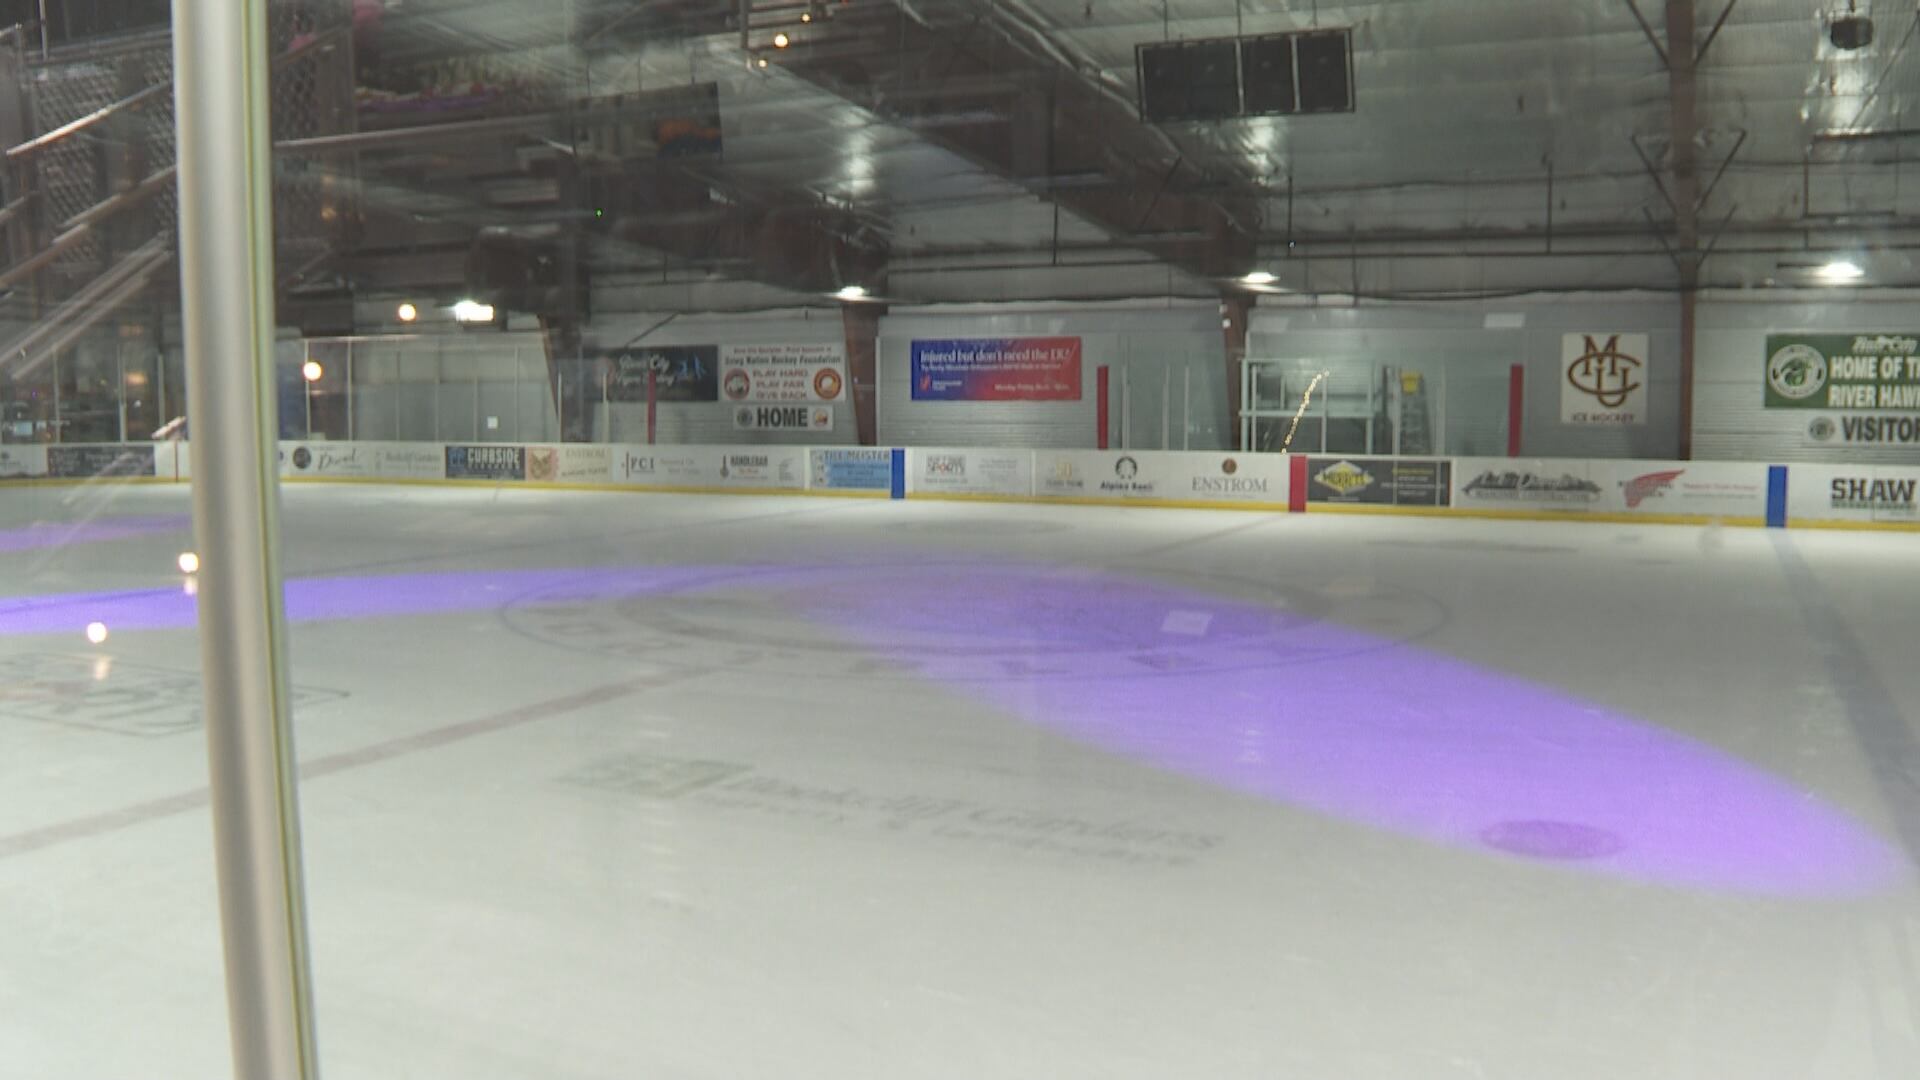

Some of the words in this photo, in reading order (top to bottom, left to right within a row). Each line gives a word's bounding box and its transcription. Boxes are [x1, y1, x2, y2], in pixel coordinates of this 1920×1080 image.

[921, 348, 957, 363] Injured
[957, 348, 975, 361] but
[1830, 356, 1878, 379] HOME
[1879, 356, 1903, 379] OF
[1828, 385, 1877, 407] RIVER
[757, 407, 808, 427] HOME
[467, 448, 521, 464] CURBSIDE
[631, 457, 655, 470] FCI
[1100, 480, 1129, 491] Alpine
[1191, 477, 1268, 492] ENSTROM
[1832, 478, 1917, 501] SHAW
